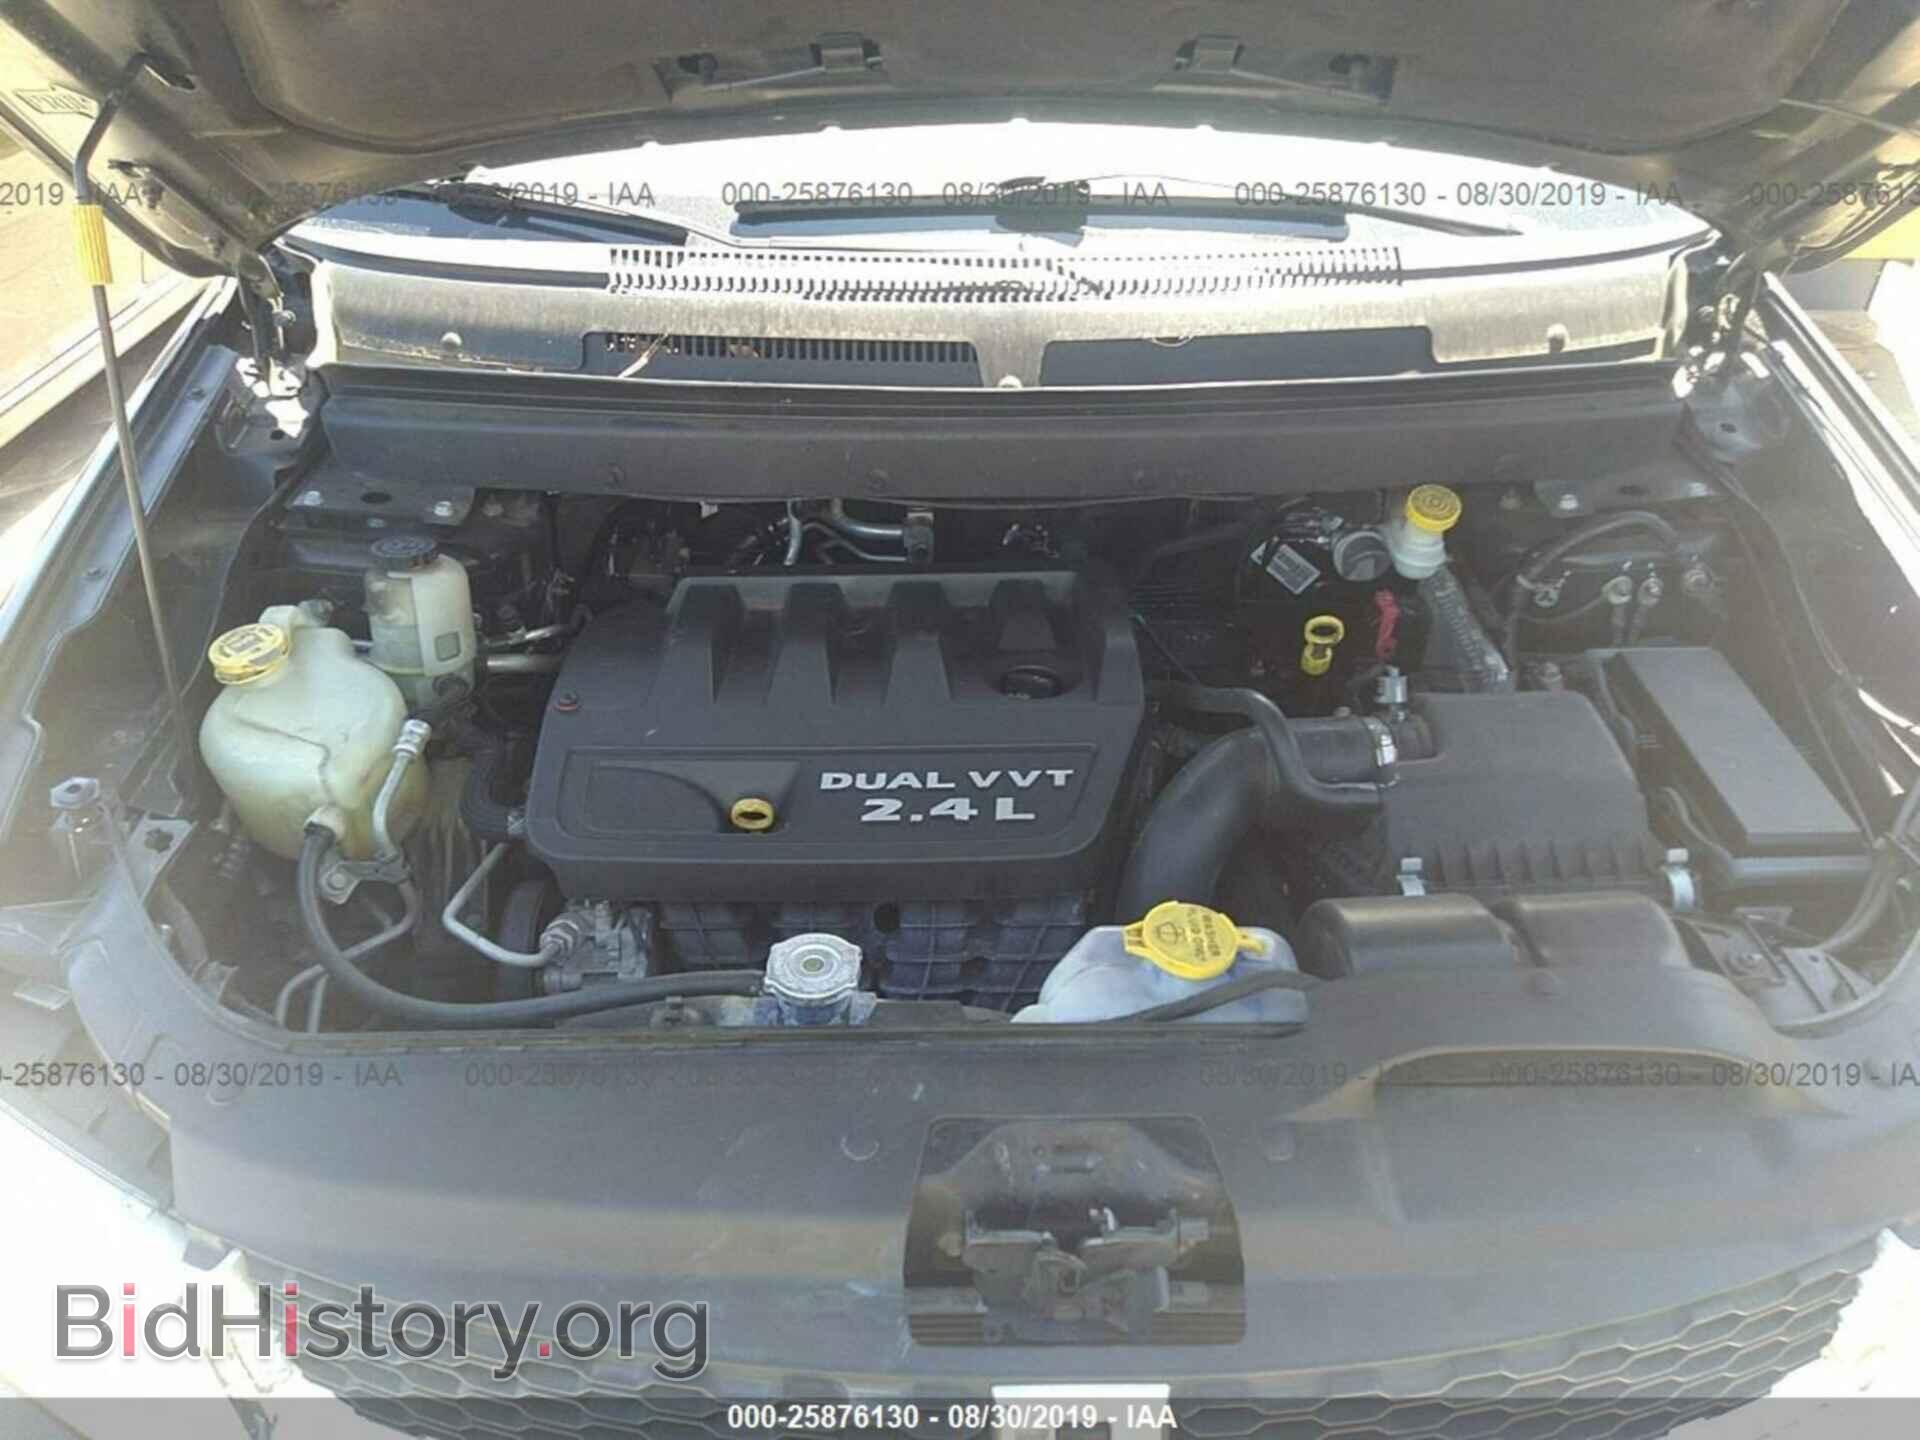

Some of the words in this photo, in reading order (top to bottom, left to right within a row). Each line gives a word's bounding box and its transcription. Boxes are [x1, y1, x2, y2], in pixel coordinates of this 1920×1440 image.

[820, 772, 955, 790] DUAL
[968, 770, 1074, 788] VVT
[861, 797, 978, 822] 2.4
[995, 797, 1036, 821] L
